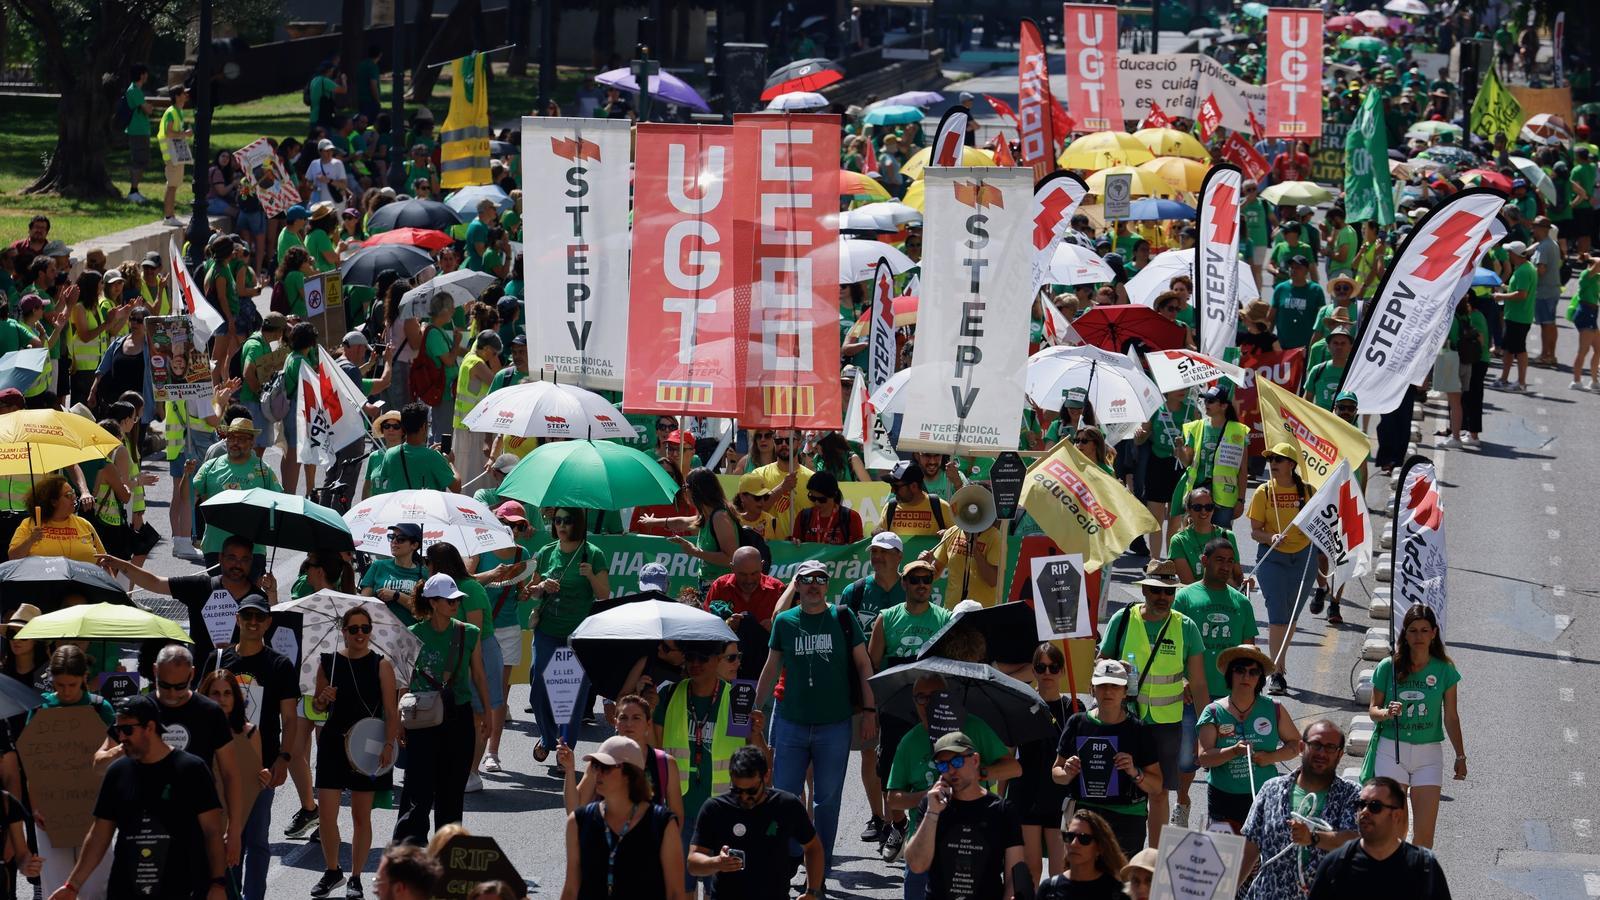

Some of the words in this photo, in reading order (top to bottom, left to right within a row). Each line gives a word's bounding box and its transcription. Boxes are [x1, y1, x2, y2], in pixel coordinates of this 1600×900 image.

[1077, 13, 1104, 113] UGT
[1280, 16, 1308, 116] UGT
[1135, 79, 1152, 89] es
[565, 166, 592, 351] STEPV
[663, 143, 724, 364] UGT
[1206, 247, 1226, 322] STEPV
[951, 214, 990, 420] STEPV
[1365, 280, 1417, 368] STEPV
[544, 354, 614, 369] INTERSINDICAL
[556, 364, 614, 377] VALENCIANA
[1245, 362, 1291, 388] ROU
[920, 423, 1001, 436] INTERSINDICAL
[932, 432, 1000, 446] VALENCIANA
[1034, 473, 1102, 535] educació
[609, 551, 644, 576] HA
[1051, 563, 1070, 576] RIP
[393, 579, 417, 590] LLENGU
[213, 592, 228, 600] RIP
[795, 636, 804, 652] LA
[555, 650, 573, 661] RIP
[113, 680, 128, 688] RIP
[1092, 743, 1108, 751] RIP
[449, 847, 499, 871] RIP
